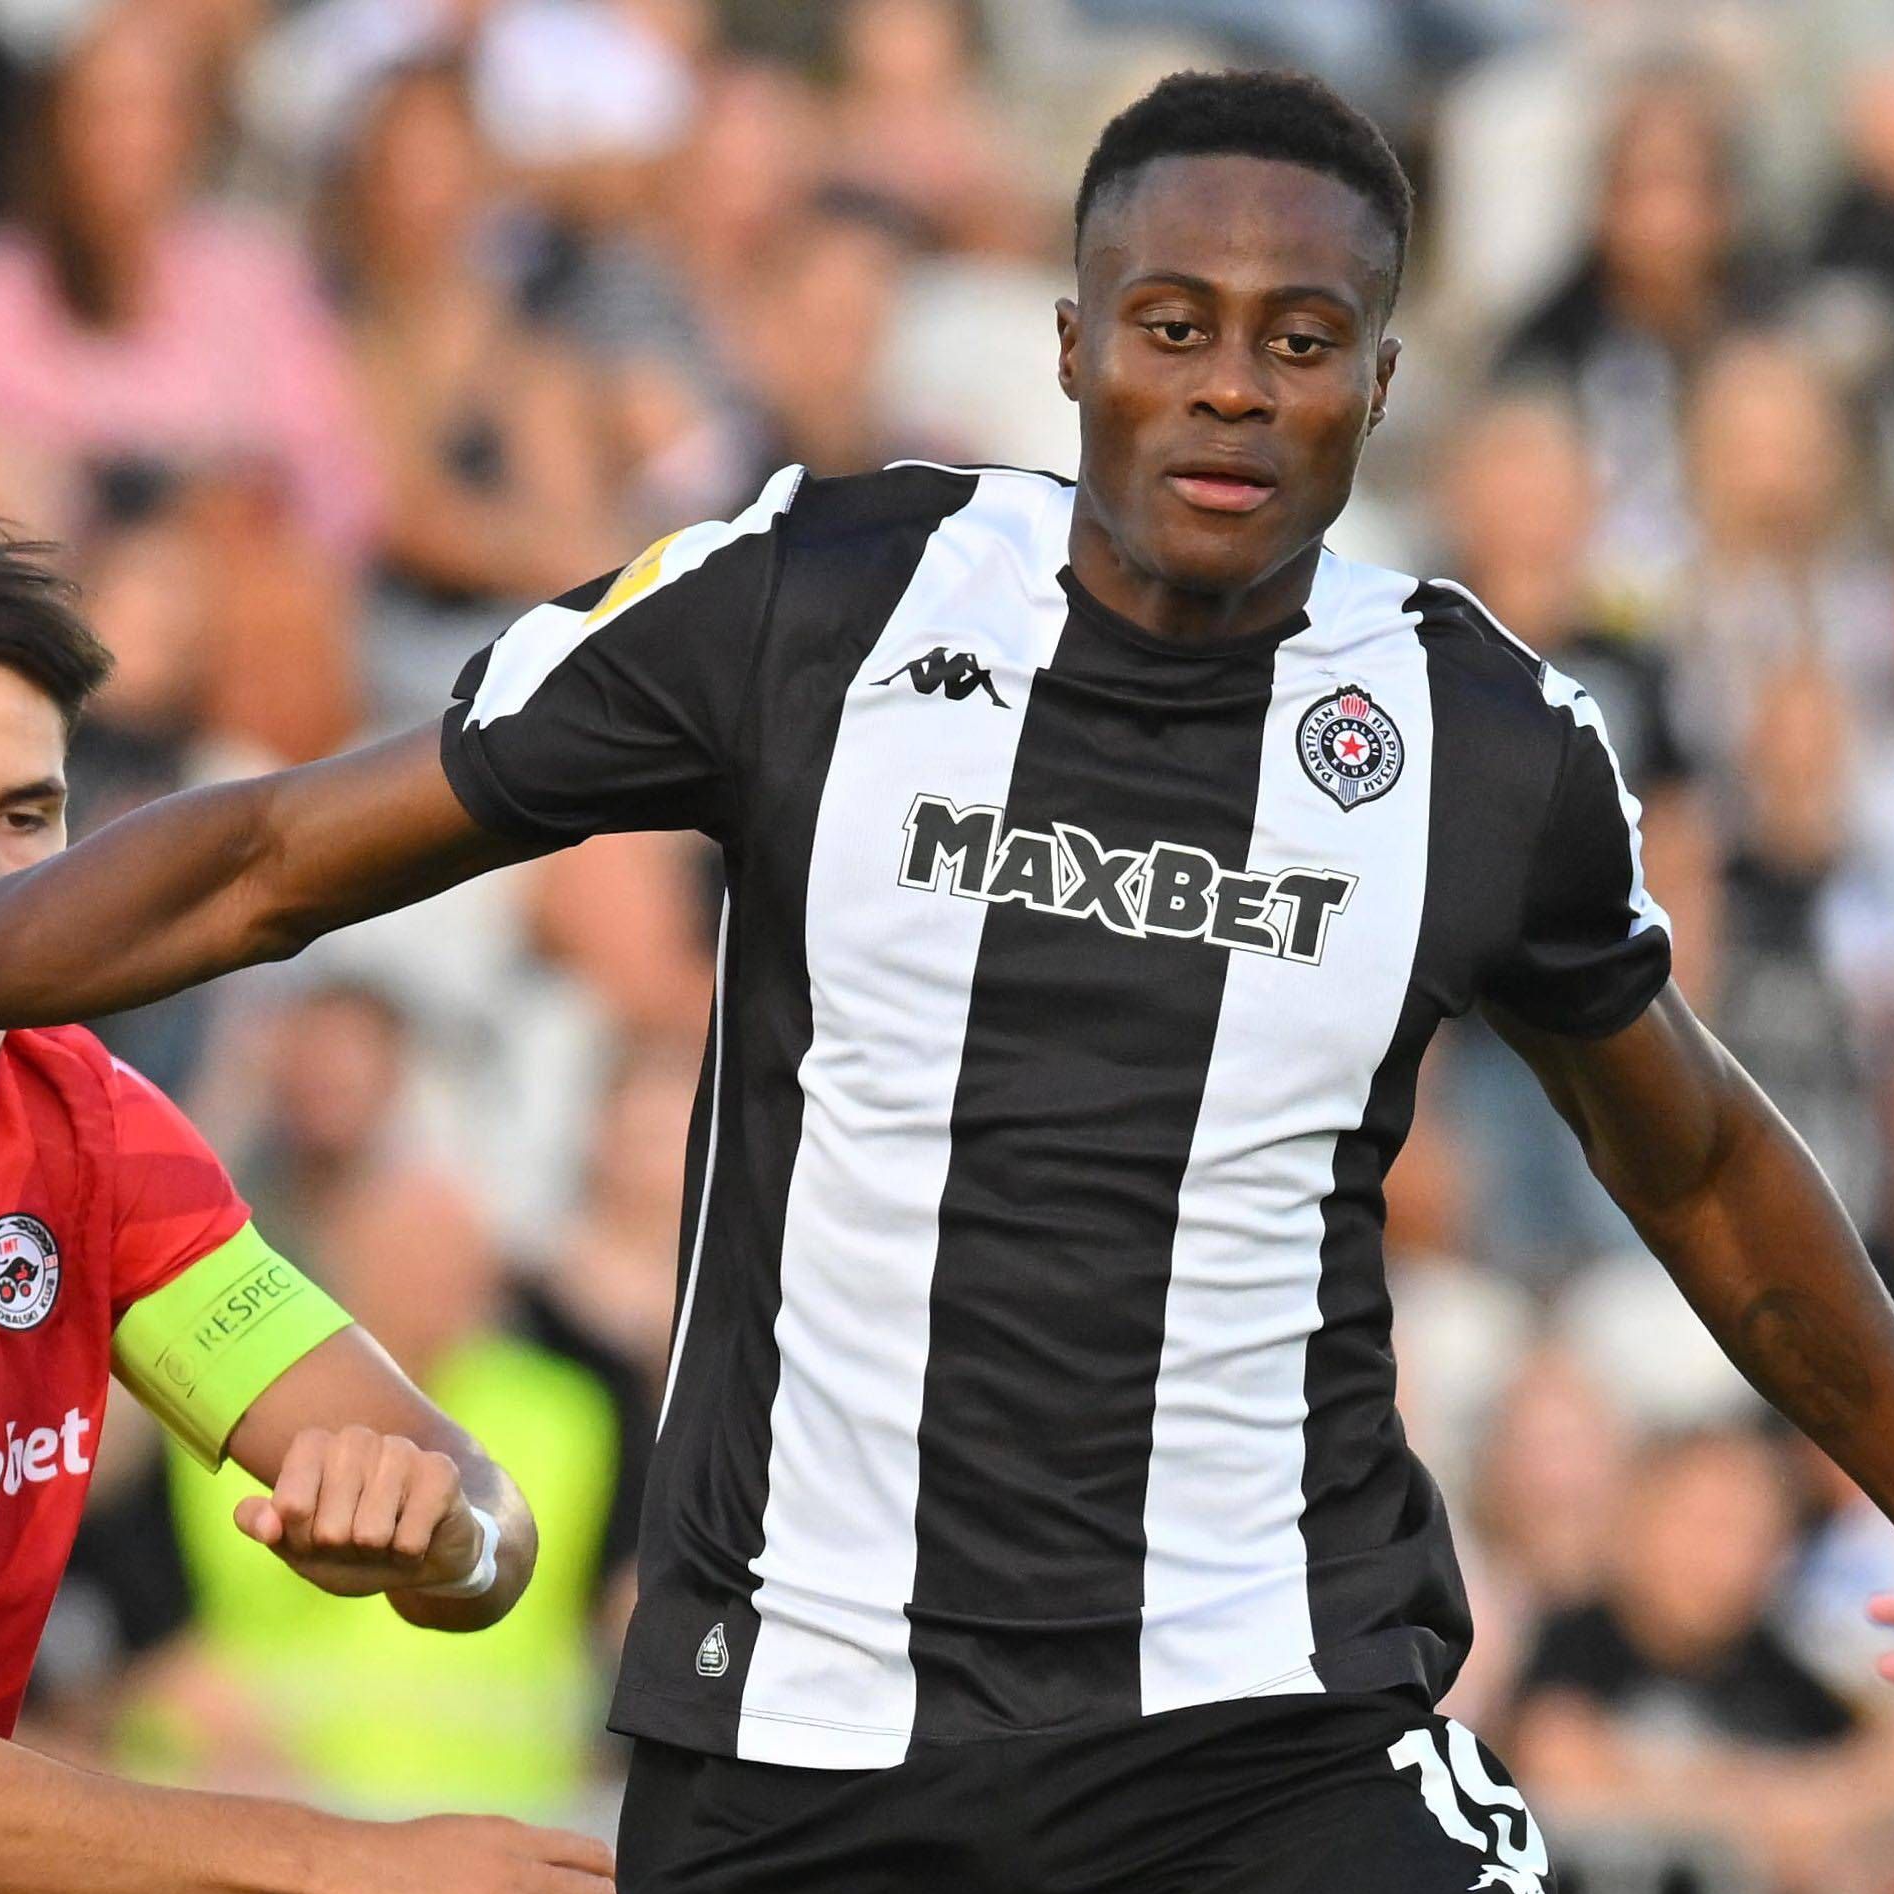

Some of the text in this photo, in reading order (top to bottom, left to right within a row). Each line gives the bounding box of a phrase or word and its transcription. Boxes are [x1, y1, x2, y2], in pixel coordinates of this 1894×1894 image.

[1306, 707, 1334, 783] PARTIZAN
[898, 793, 1359, 966] MAXBET
[195, 1264, 292, 1352] RESPEC
